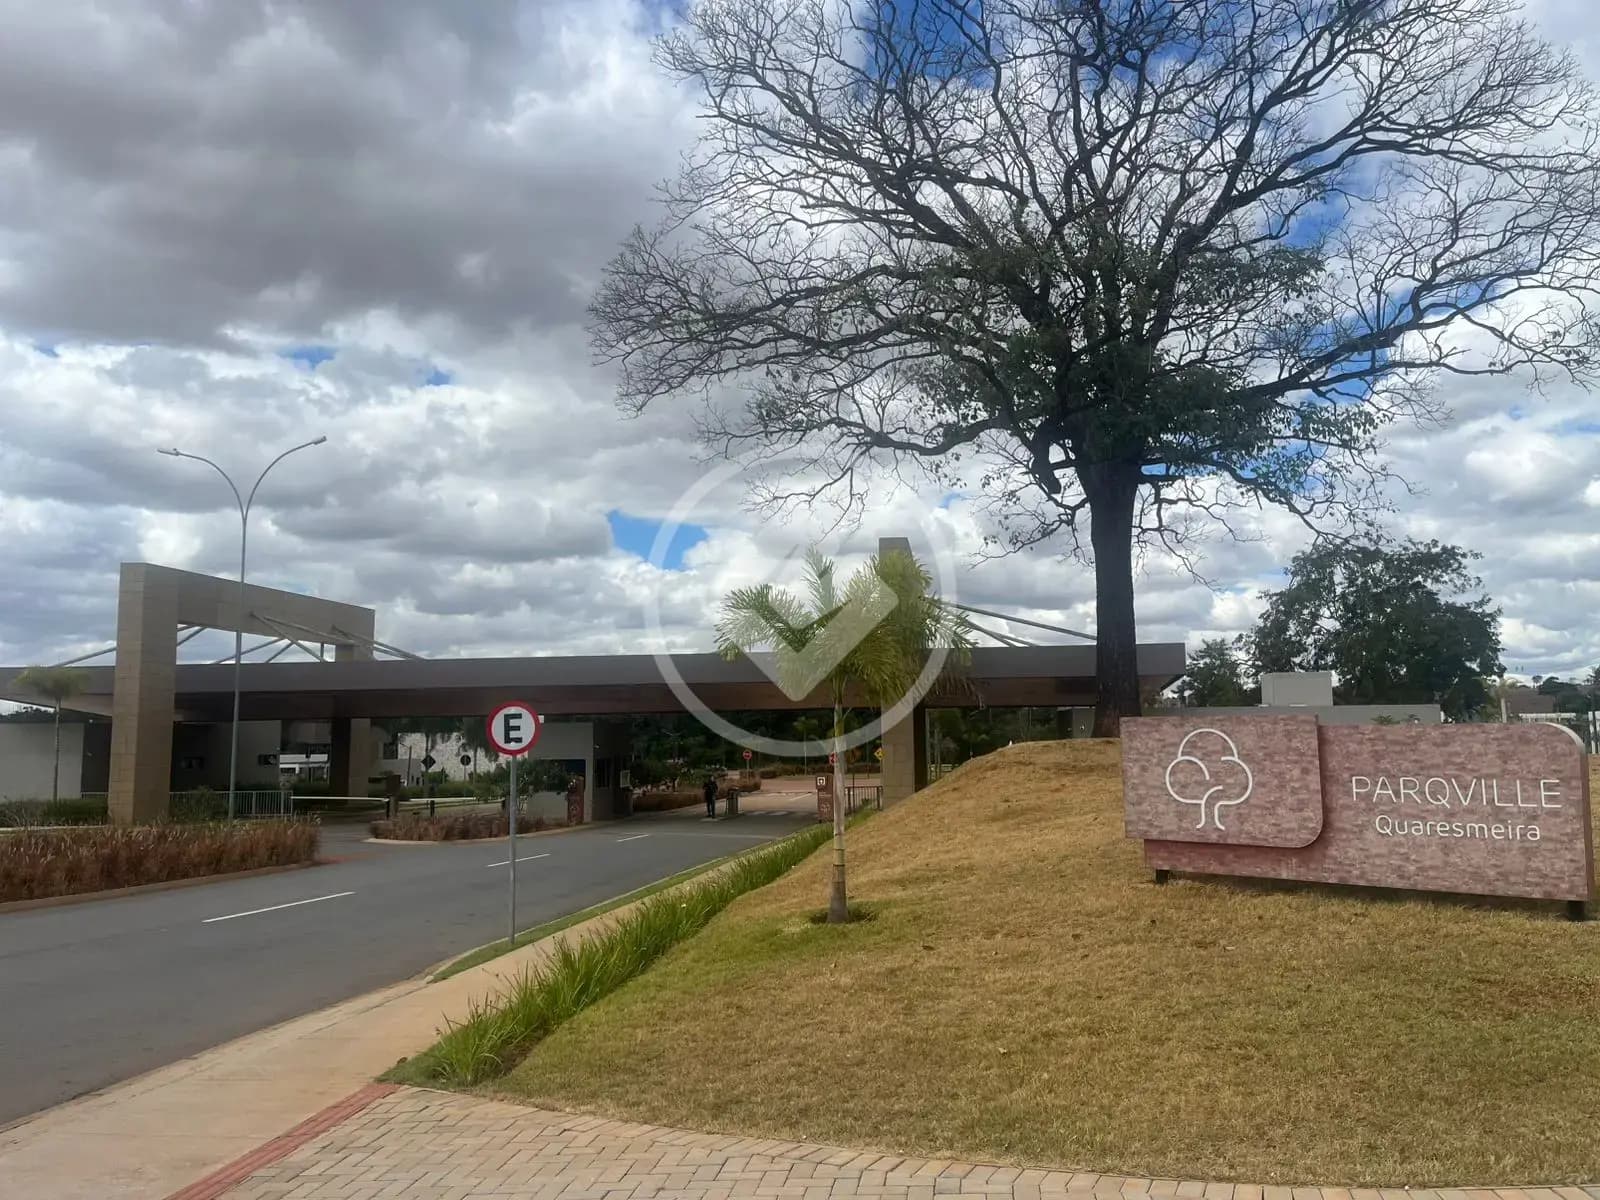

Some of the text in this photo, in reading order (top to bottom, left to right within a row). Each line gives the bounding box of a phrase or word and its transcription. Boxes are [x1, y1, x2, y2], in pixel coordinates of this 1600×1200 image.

[503, 713, 523, 744] E
[1351, 776, 1563, 809] PARQVILLE
[1375, 815, 1541, 841] Quaresmeira
